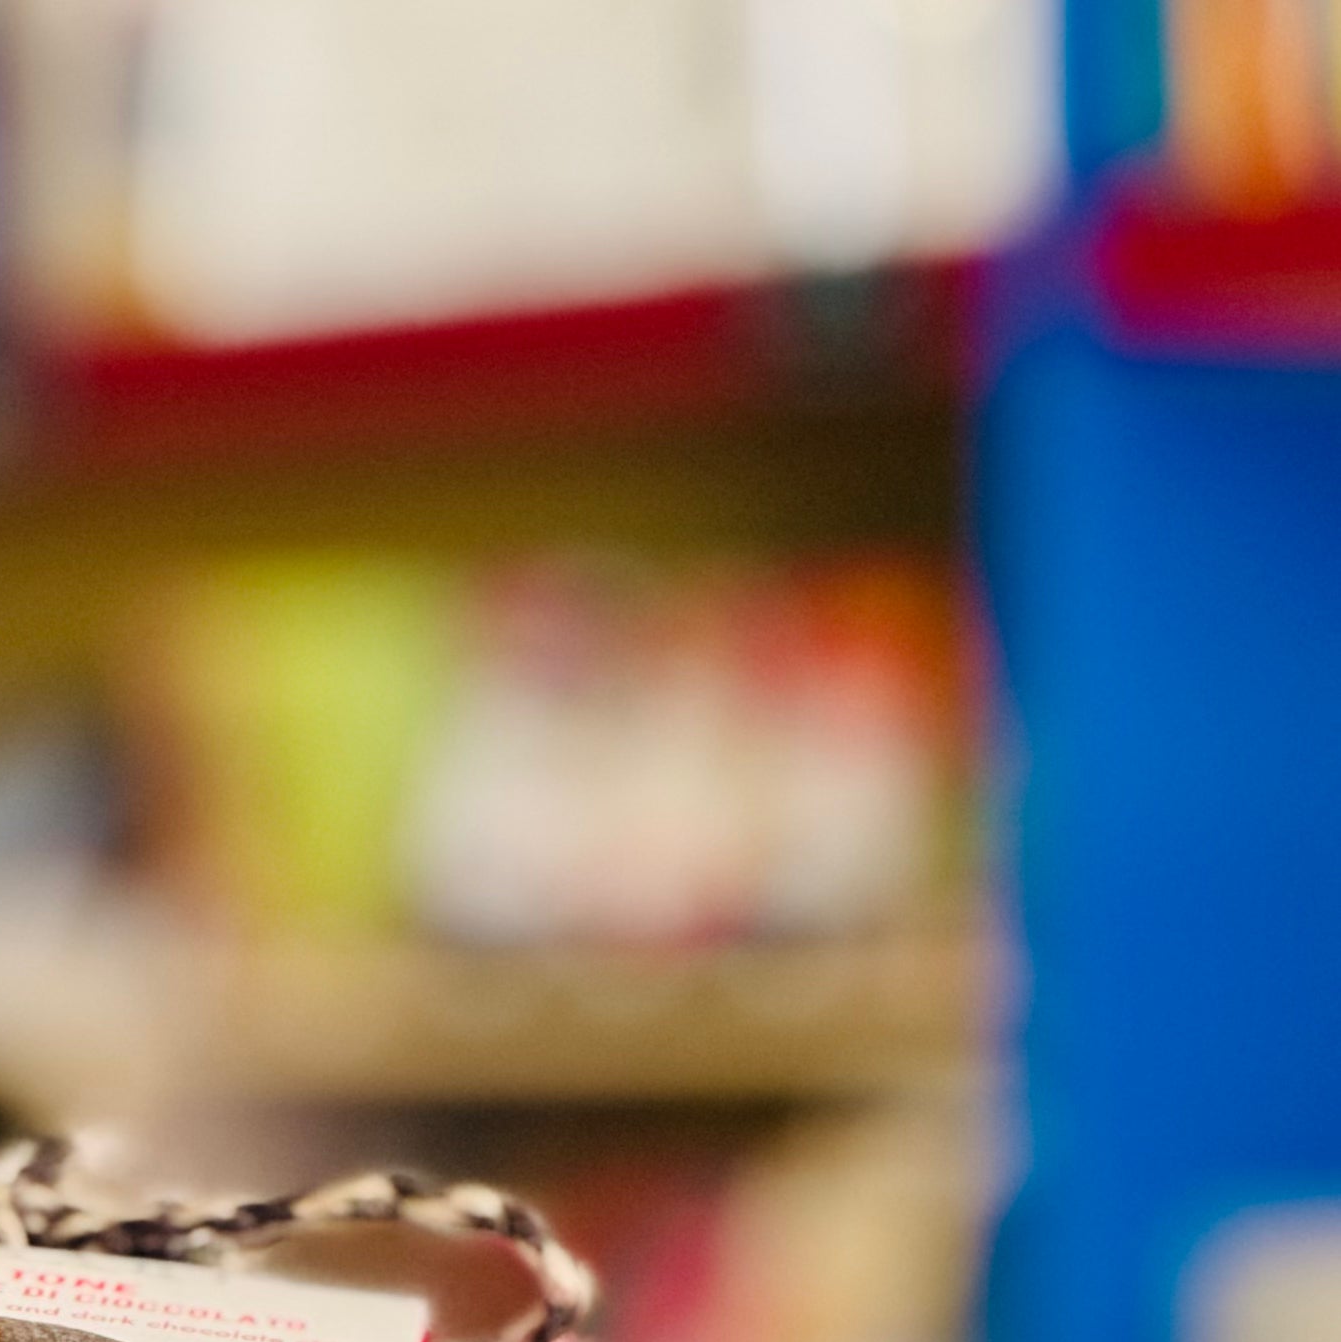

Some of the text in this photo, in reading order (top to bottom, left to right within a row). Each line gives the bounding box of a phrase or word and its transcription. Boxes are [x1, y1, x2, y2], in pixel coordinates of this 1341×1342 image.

[6, 1304, 60, 1317] and
[71, 1310, 135, 1326] dark
[23, 1286, 57, 1300] DI
[74, 1293, 307, 1332] CIOCCOLATO
